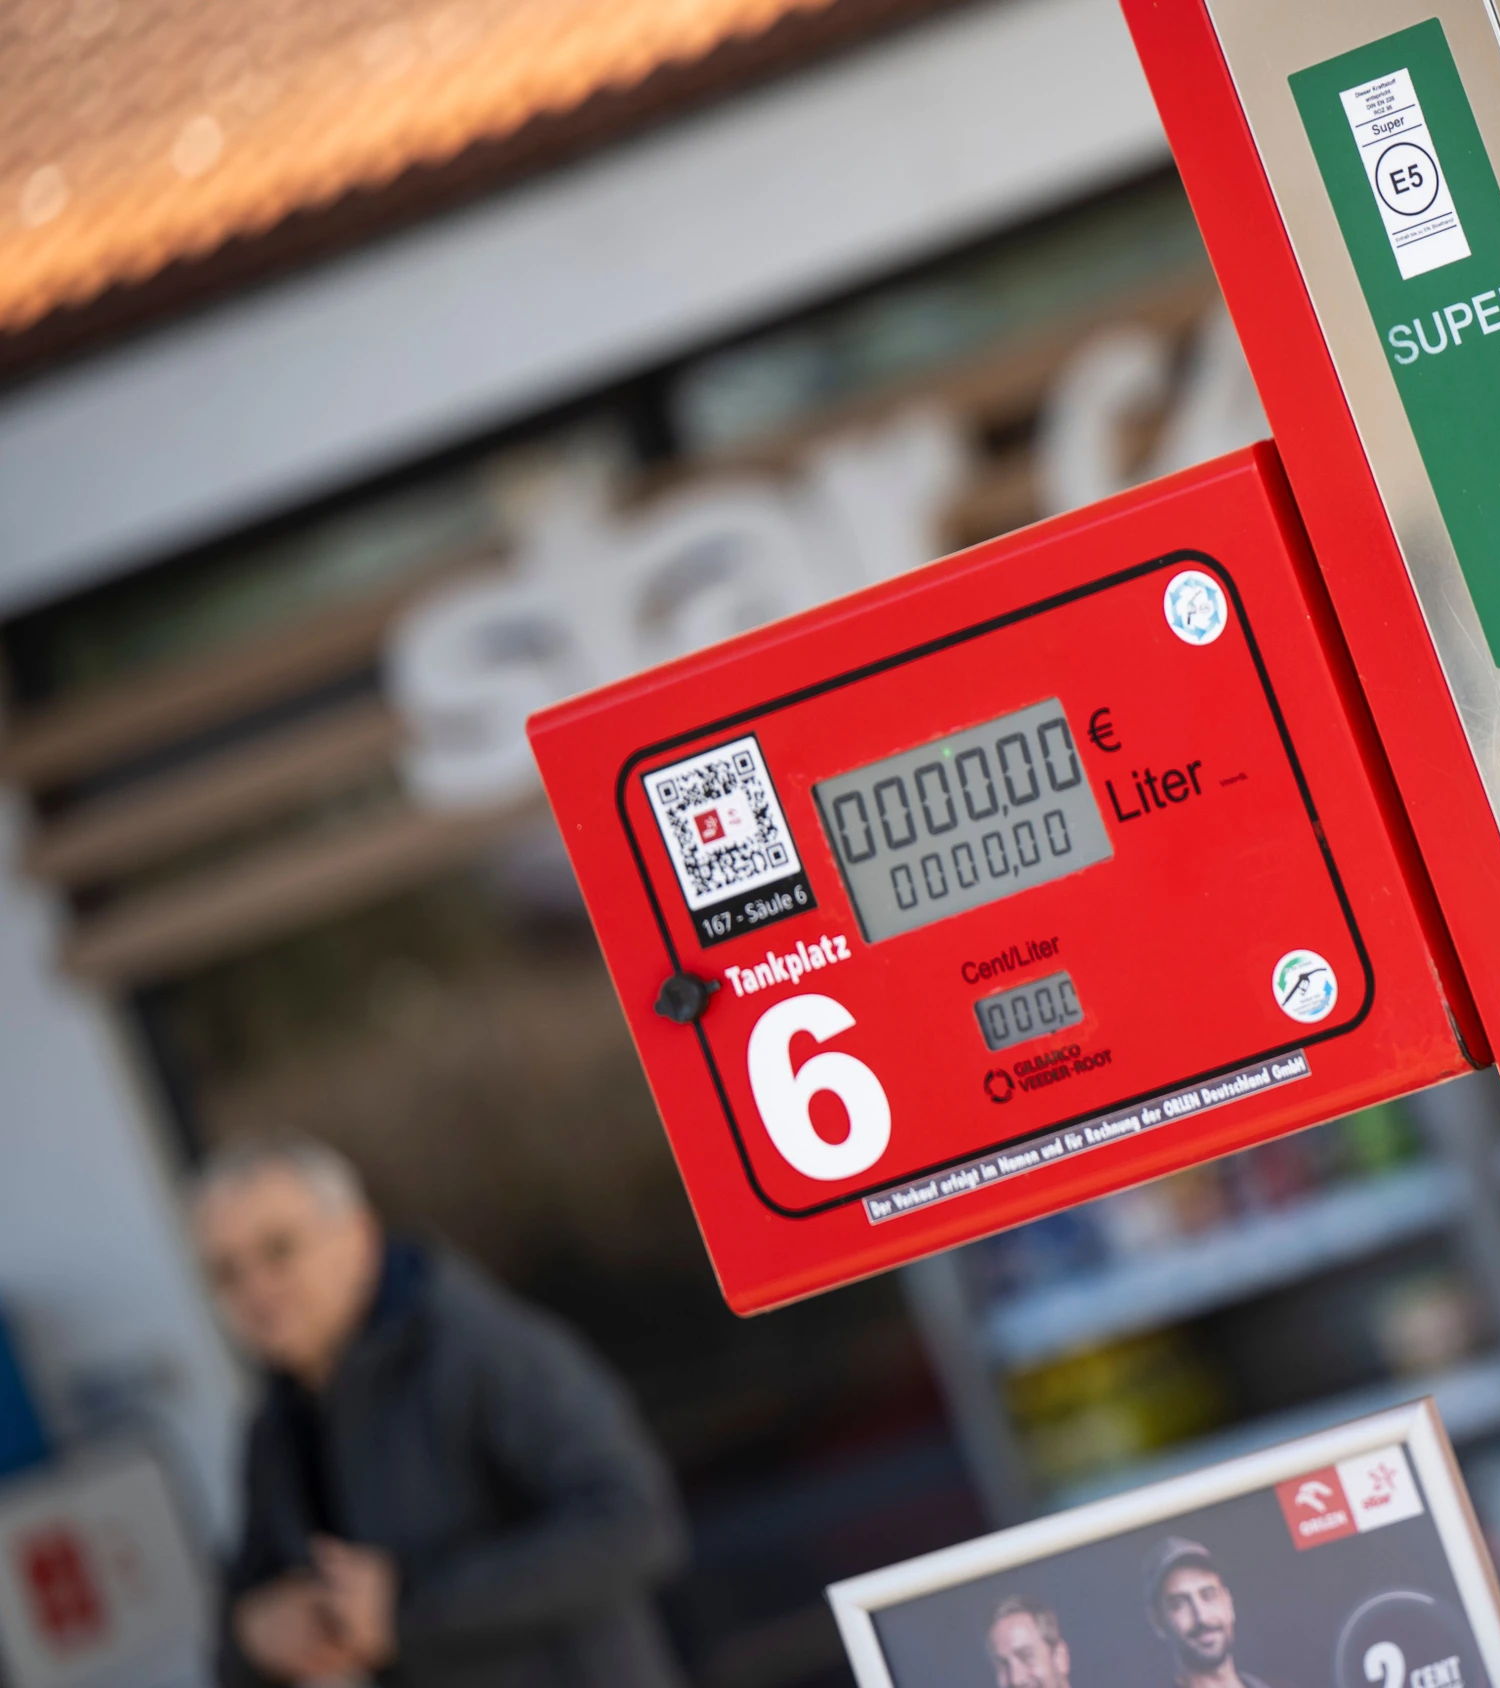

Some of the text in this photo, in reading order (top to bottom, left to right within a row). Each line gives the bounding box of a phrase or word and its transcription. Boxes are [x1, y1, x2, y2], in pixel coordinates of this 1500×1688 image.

[1371, 116, 1405, 136] Super
[1389, 161, 1424, 196] E5
[1087, 707, 1122, 753] €
[832, 717, 1082, 865] 0000,00
[1105, 760, 1202, 823] Liter
[890, 809, 1072, 910] 0000,00
[703, 912, 731, 936] 167
[745, 894, 792, 922] Säule
[794, 885, 807, 904] 6
[726, 936, 849, 994] Tankplatz
[961, 936, 1061, 986] Cent/Liter
[1014, 1044, 1080, 1076] GILBARCO
[1019, 1050, 1111, 1091] VEEDER-ROOT
[746, 992, 893, 1182] 6
[870, 1057, 1305, 1217] Der Verkauf erfolgt im Namen und für Rechnung der ORLEN Deutschland GmbH
[1299, 1510, 1348, 1537] ORLEN
[1363, 1641, 1406, 1688] 2
[1410, 1655, 1462, 1688] CENT
